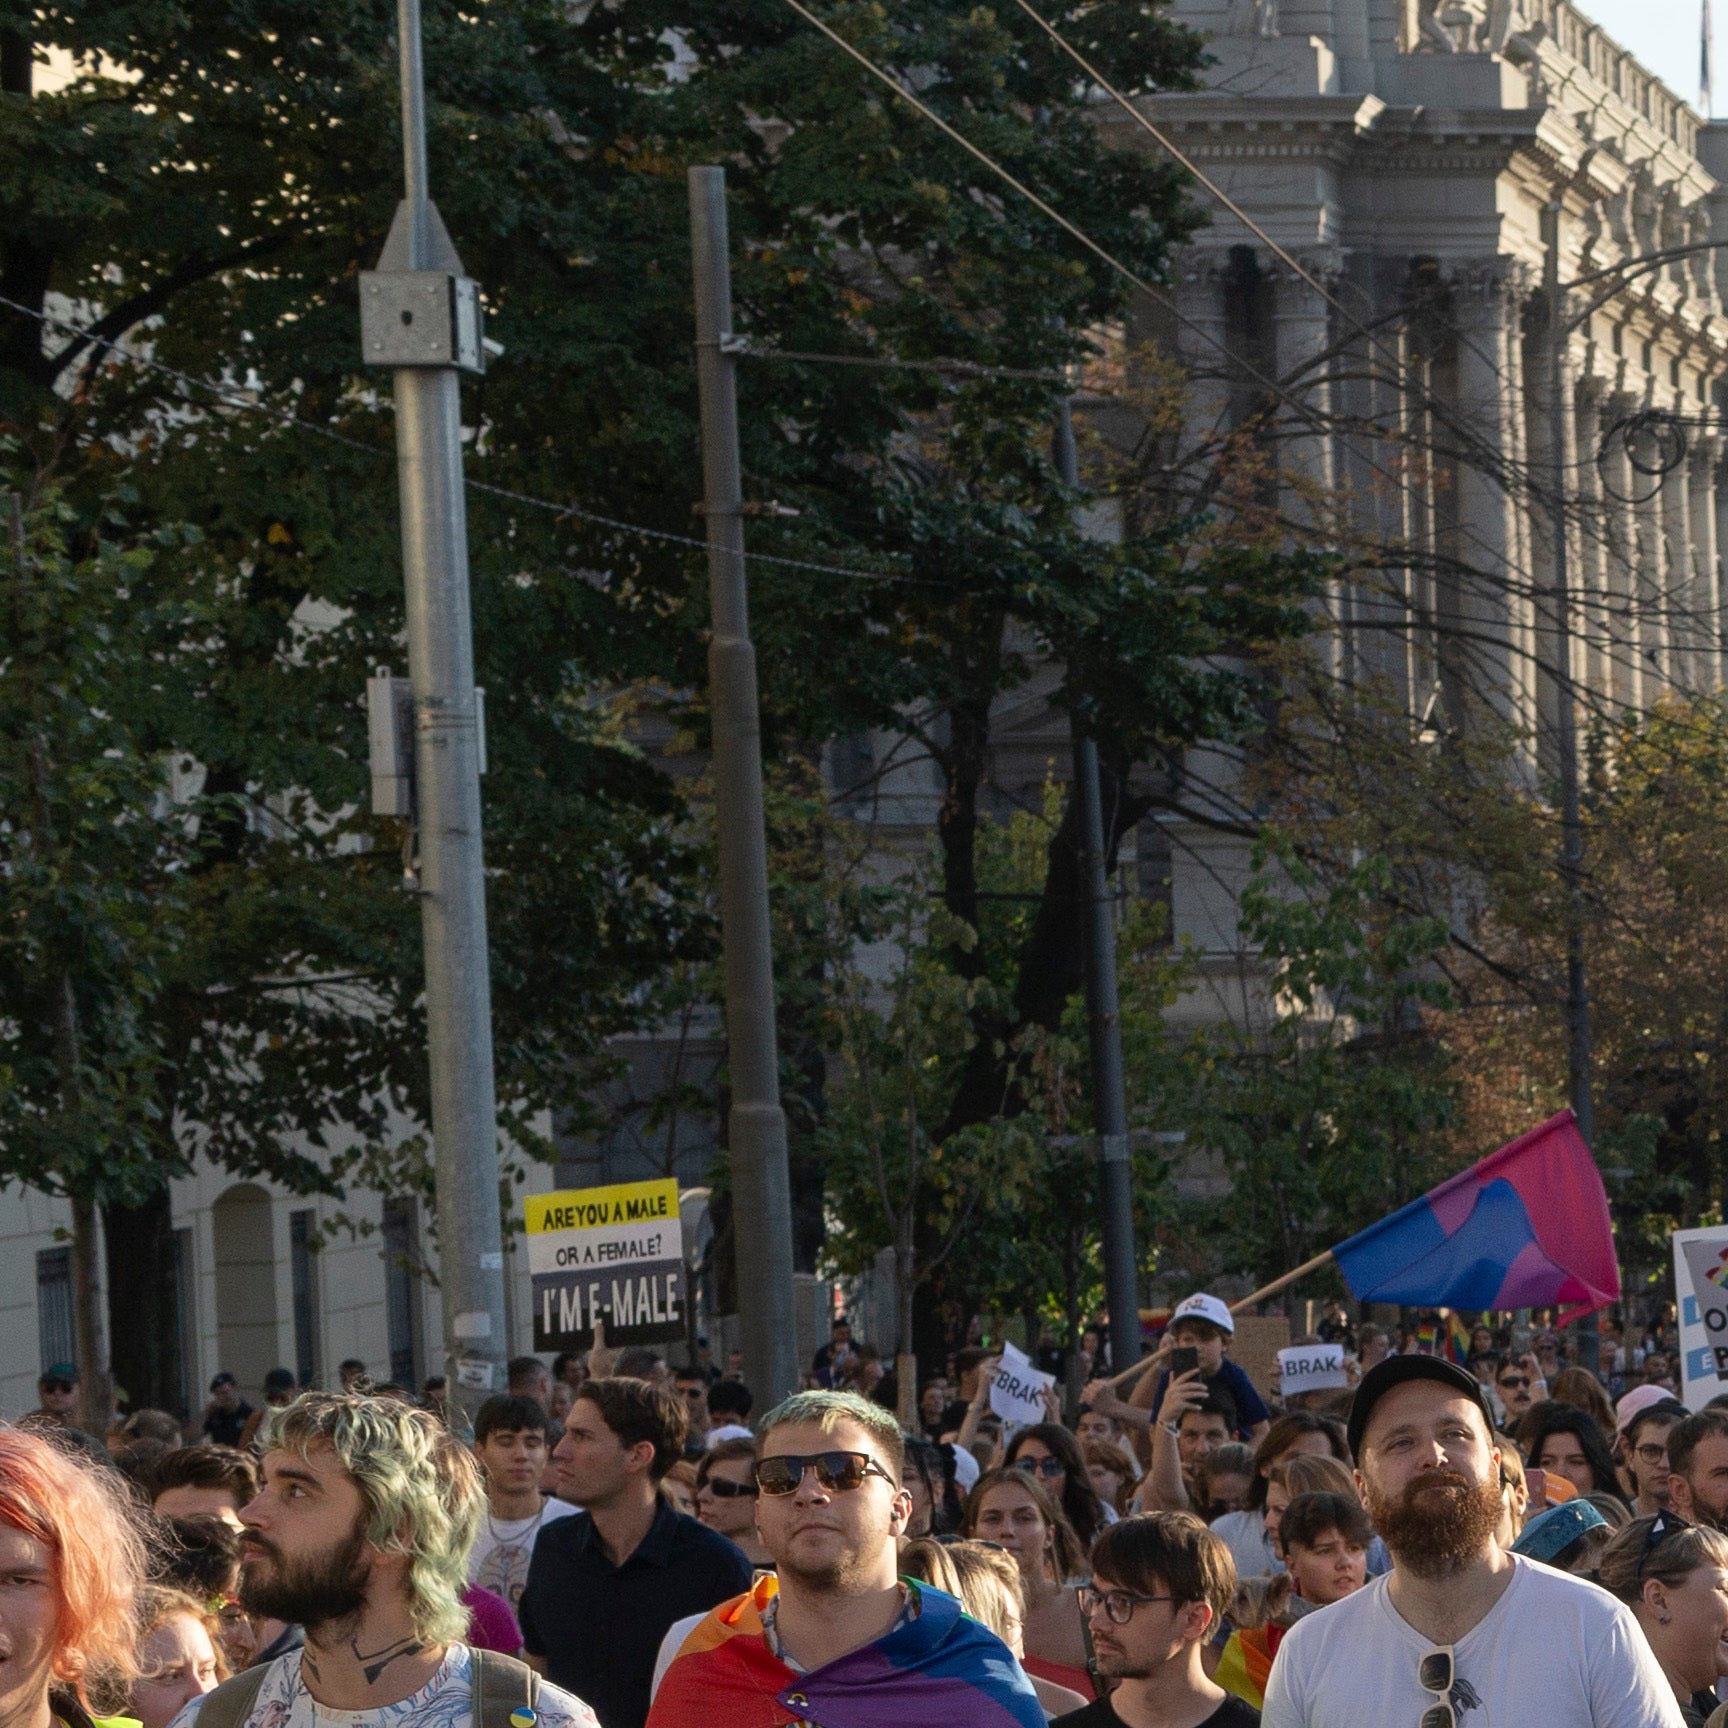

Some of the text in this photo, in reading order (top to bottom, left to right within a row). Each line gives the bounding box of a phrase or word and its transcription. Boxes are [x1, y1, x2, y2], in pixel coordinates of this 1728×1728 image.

[613, 1201, 623, 1222] A
[626, 1196, 668, 1219] MALE
[556, 1233, 662, 1266] OR A FEMALE?
[543, 1273, 679, 1335] I'M E-MALE
[1285, 1356, 1338, 1378] BRAK
[996, 1372, 1041, 1407] BRAK
